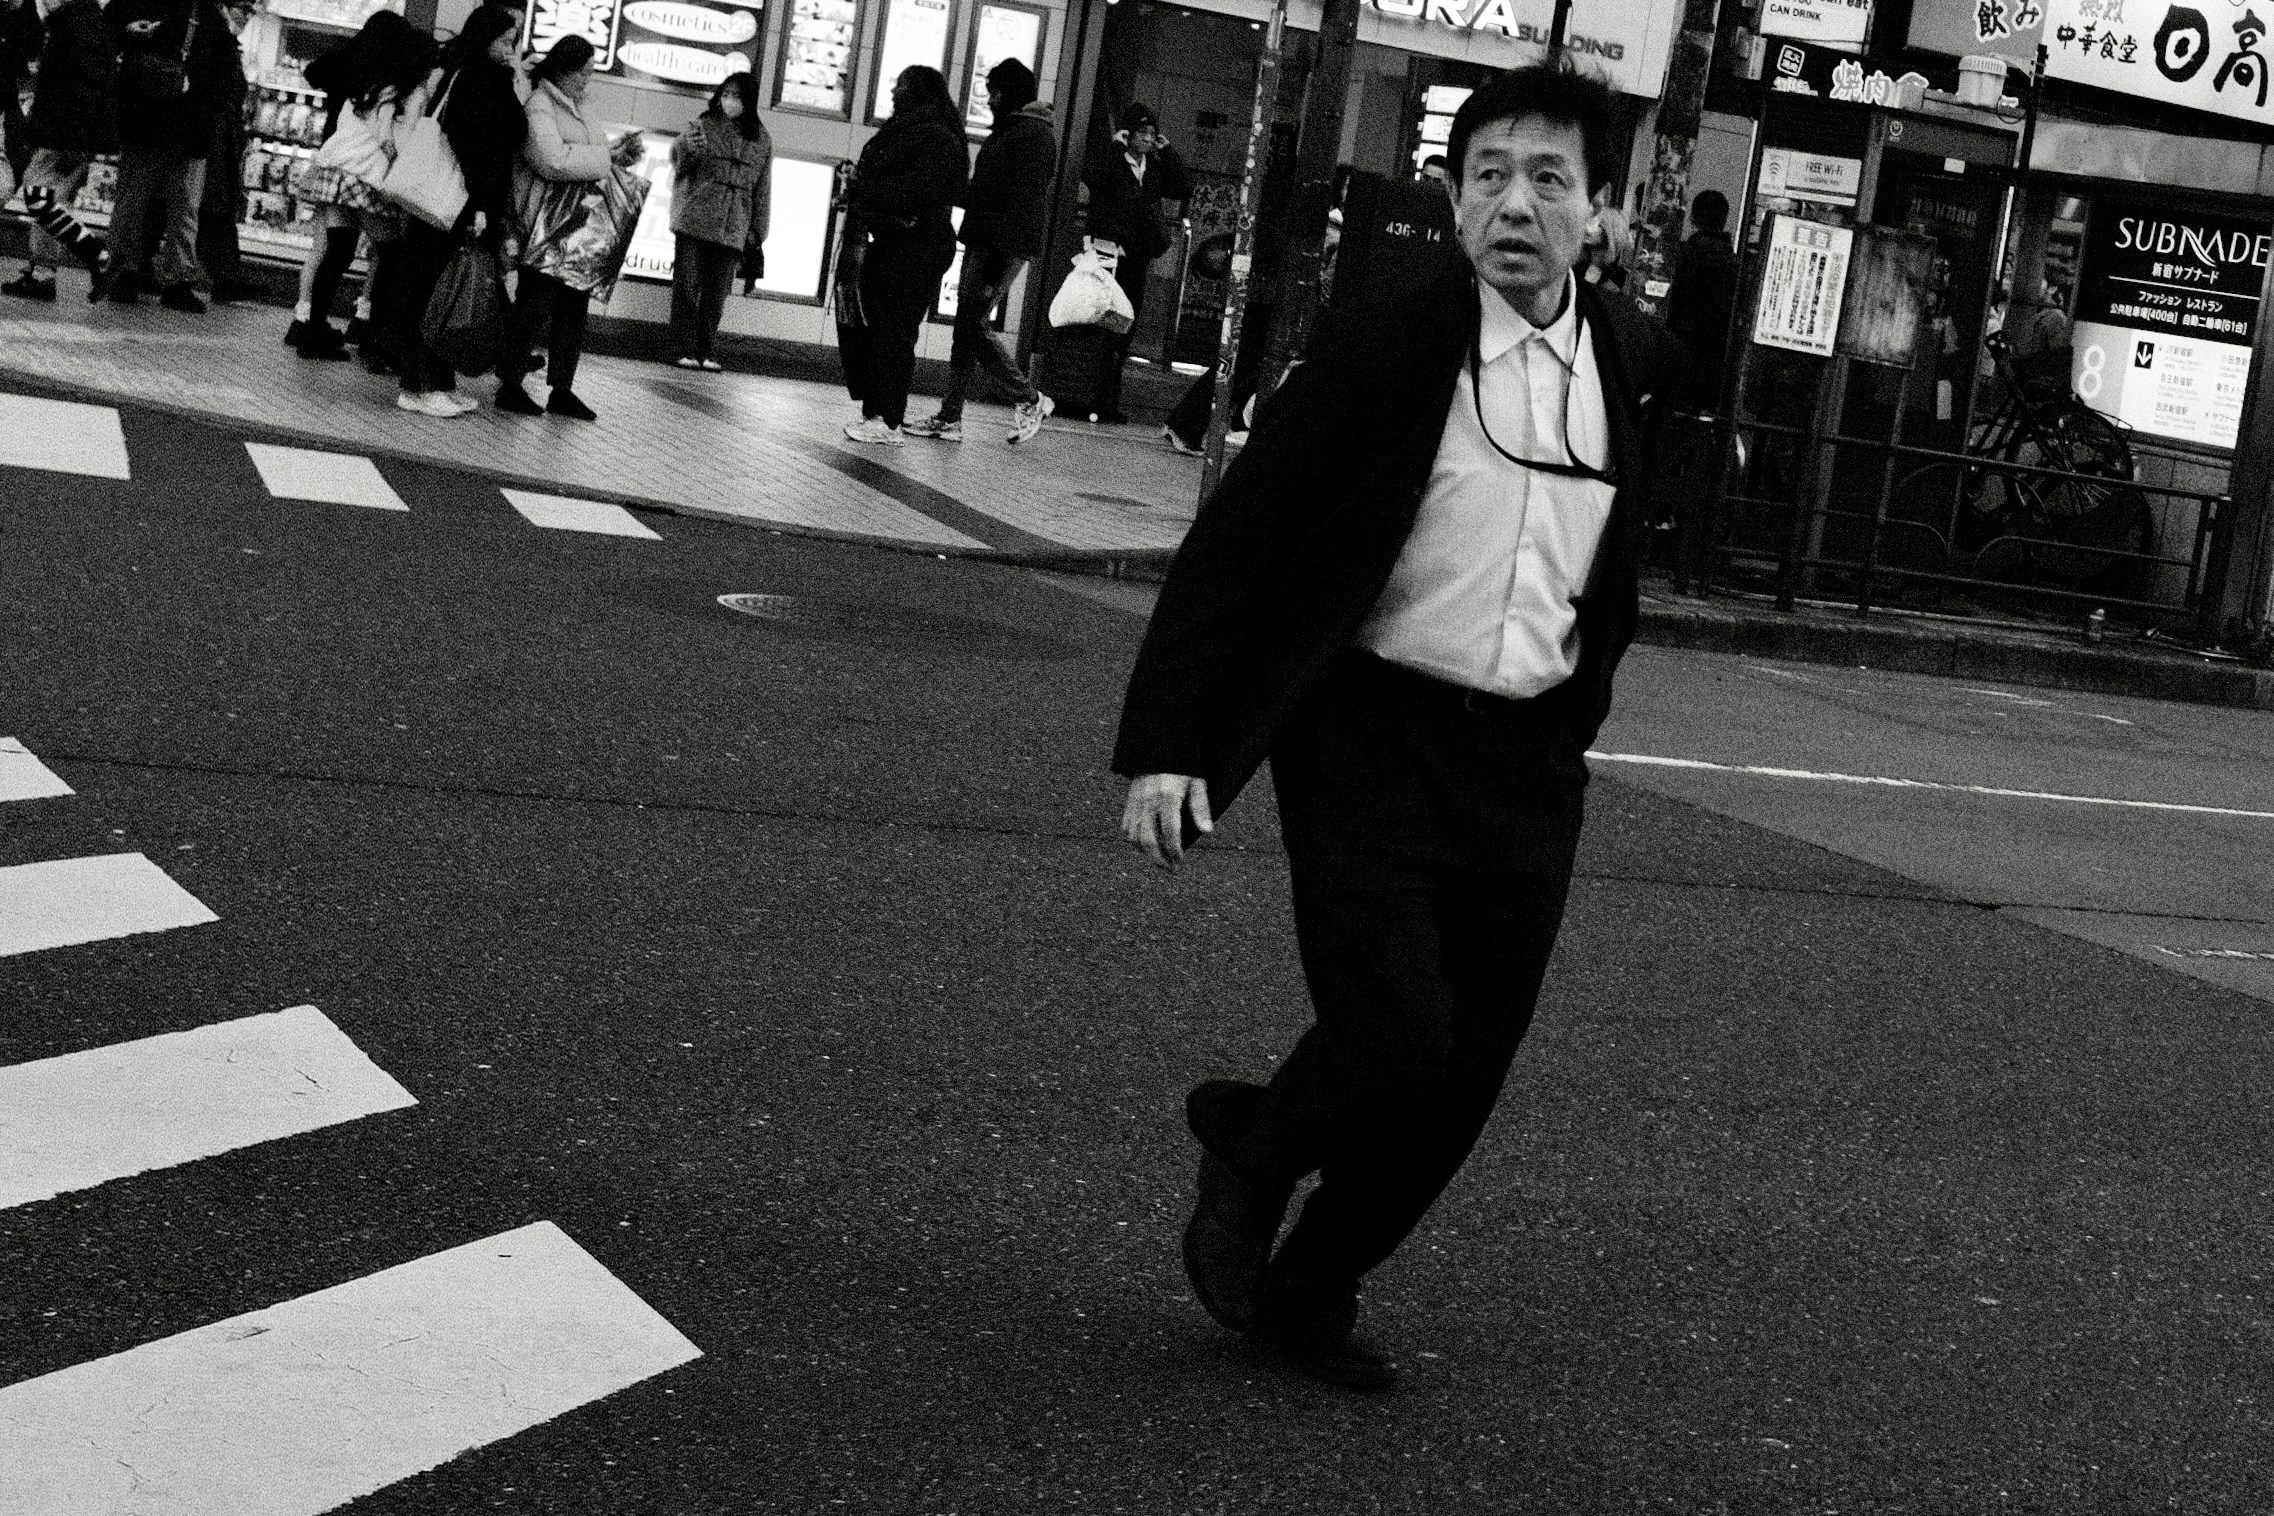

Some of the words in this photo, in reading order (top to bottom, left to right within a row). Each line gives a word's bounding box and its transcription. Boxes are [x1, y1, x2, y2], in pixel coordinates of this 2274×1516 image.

[630, 9, 729, 34] cosmetics
[1770, 4, 1790, 15] CAN
[1792, 8, 1821, 21] DRINK
[2057, 21, 2138, 64] 中華食堂
[626, 43, 679, 69] health
[1805, 161, 1822, 174] FREE
[2114, 217, 2272, 268] SUBNADE
[625, 252, 674, 275] drug
[2151, 262, 2220, 285] 新宿サブナード
[2138, 290, 2182, 306] ファッション
[2186, 297, 2223, 313] レストラン
[2078, 344, 2106, 399] 8
